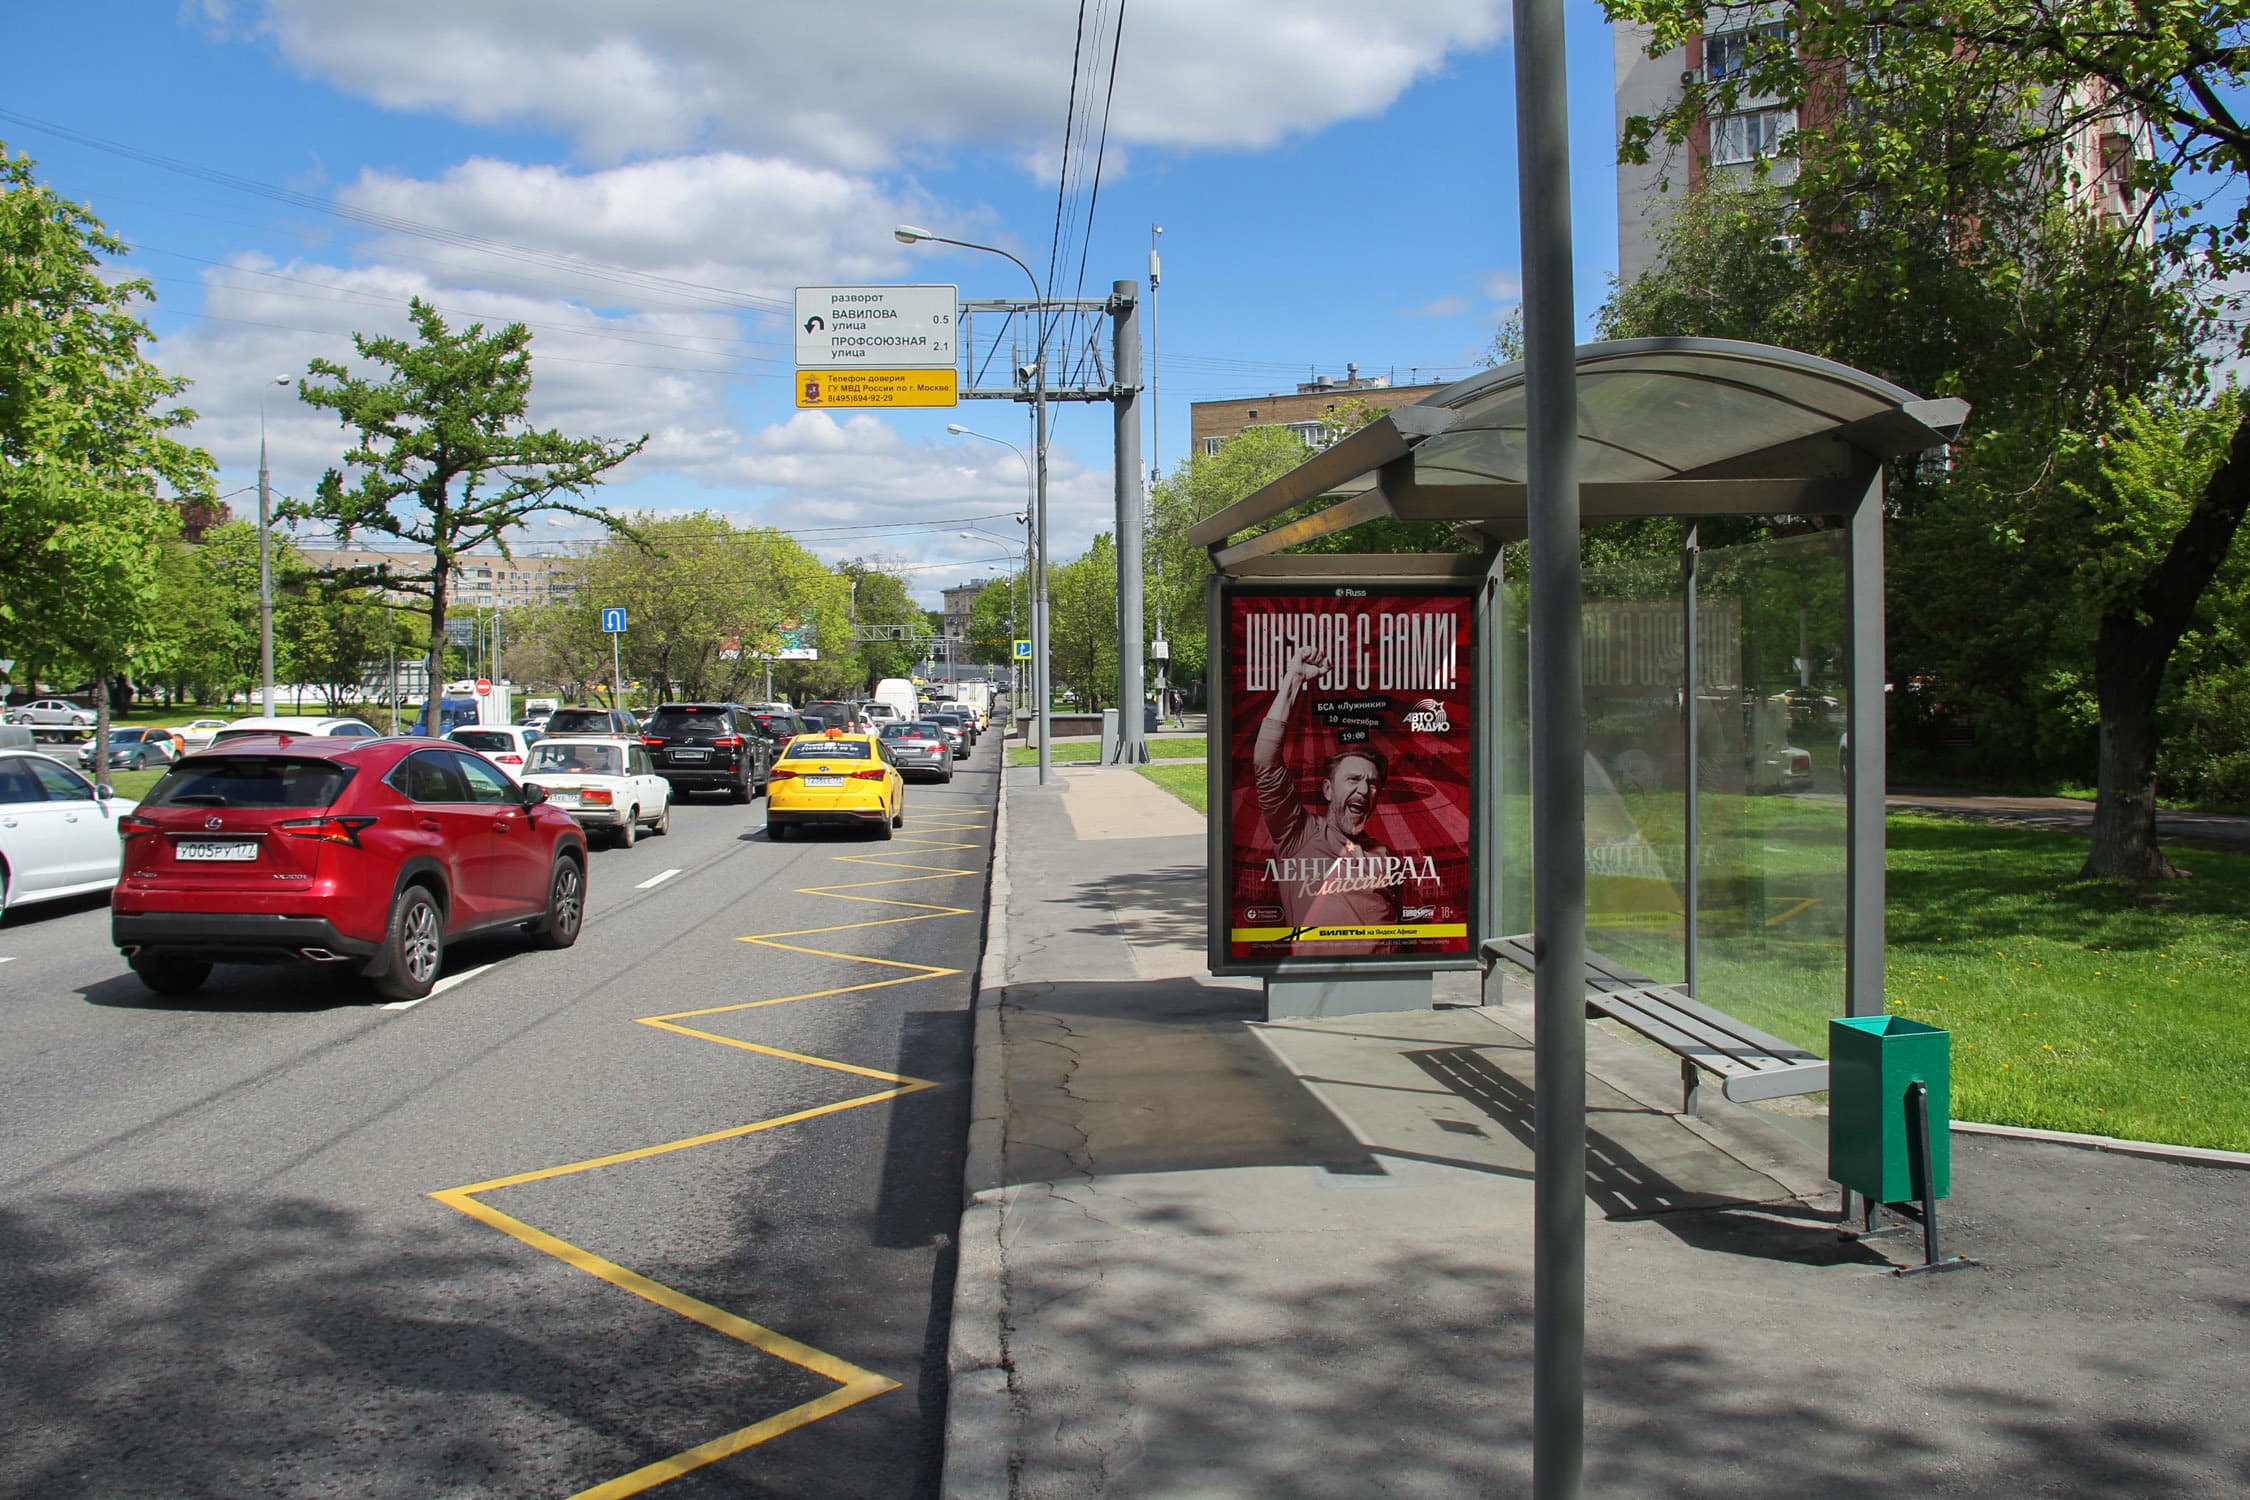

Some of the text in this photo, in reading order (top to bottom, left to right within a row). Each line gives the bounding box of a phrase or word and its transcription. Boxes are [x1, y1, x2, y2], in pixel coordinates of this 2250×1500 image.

[831, 294, 884, 304] разворот
[832, 309, 898, 319] ВАВИЛОВА
[932, 315, 950, 324] 0.5
[832, 322, 866, 332] улица
[831, 336, 927, 346] ПРОФСОЮЗНАЯ
[933, 342, 949, 351] 2.1
[831, 349, 866, 359] улица
[828, 375, 906, 383] Телефон доверия
[827, 384, 838, 392] ГУ
[840, 384, 860, 393] МВД
[862, 384, 894, 392] России
[828, 394, 893, 403] 8(495)694-92-29
[1345, 588, 1367, 597] Russ
[1246, 612, 1457, 691] ШНУРОВ С ВАМИ!
[1317, 701, 1386, 712] БСА «Лужники»
[1328, 715, 1379, 727] 10 сентября
[1403, 712, 1434, 723] АВТО
[1411, 721, 1450, 732] РАДИО
[1342, 731, 1365, 741] 19:00
[180, 843, 256, 858] У005РУ 177
[1260, 855, 1441, 887] ЛЕНИНГРАД
[1298, 871, 1405, 898] Классика
[1440, 906, 1454, 919] 18+
[1319, 929, 1366, 937] БИЛЕТЫ
